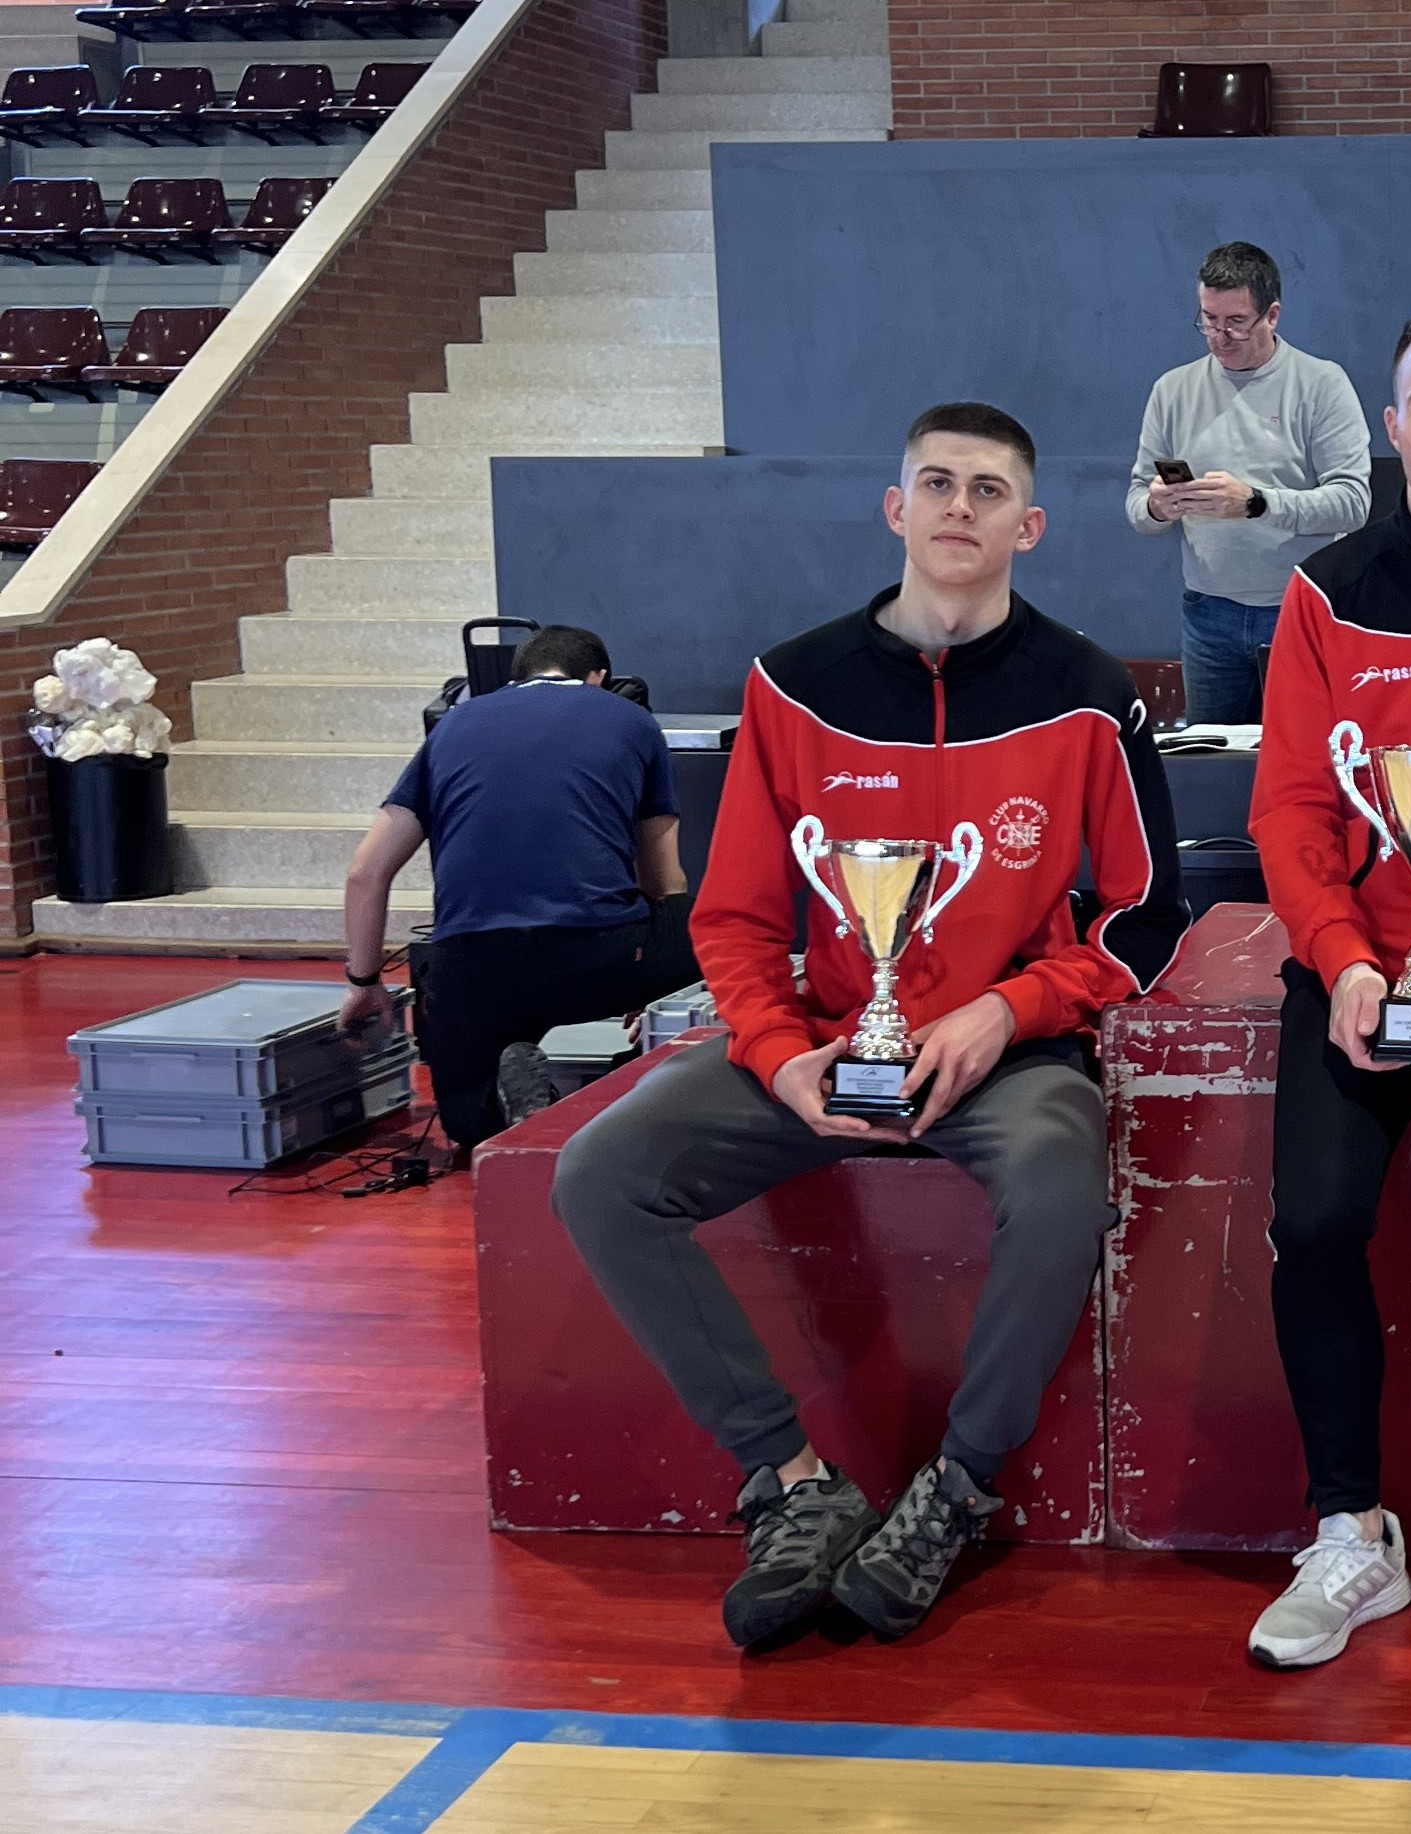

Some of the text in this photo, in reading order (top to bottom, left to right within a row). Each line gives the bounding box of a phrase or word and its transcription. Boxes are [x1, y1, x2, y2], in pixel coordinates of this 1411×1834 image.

[856, 771, 899, 789] rasán
[988, 796, 1050, 826] CLUB NAVARRO
